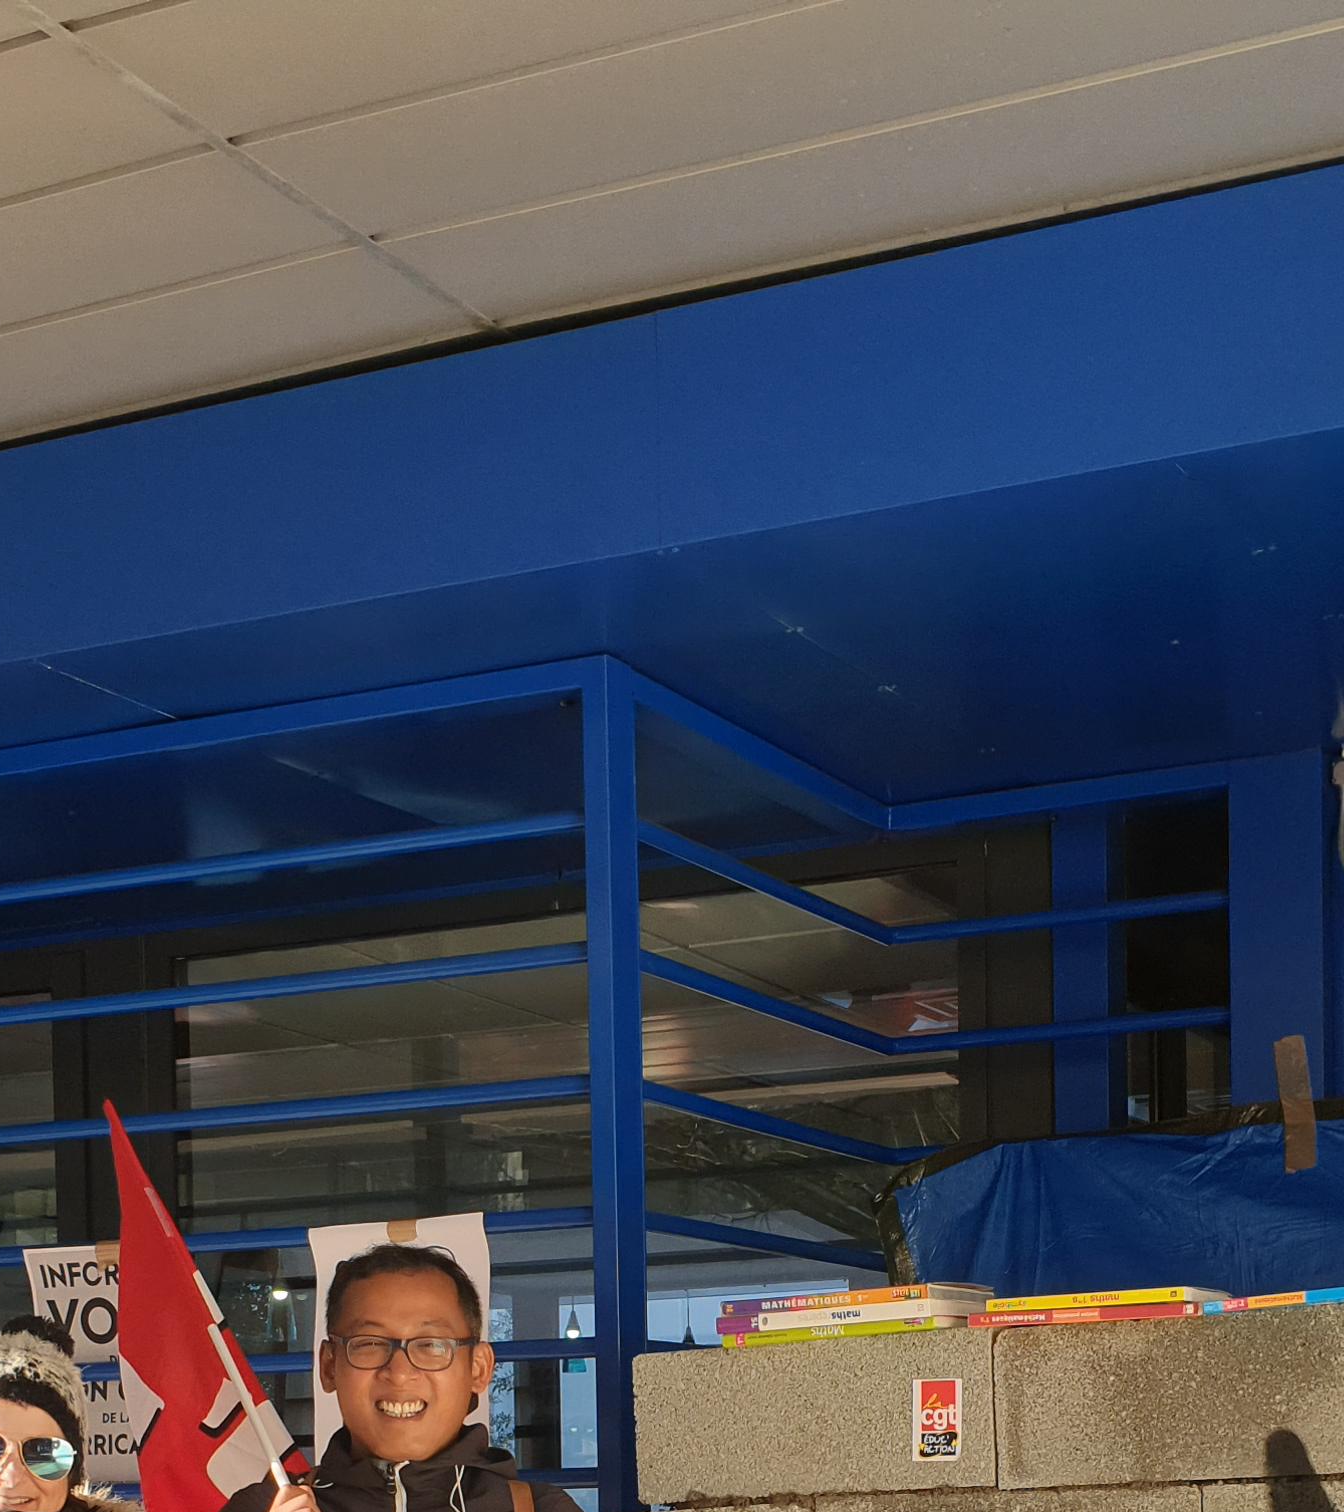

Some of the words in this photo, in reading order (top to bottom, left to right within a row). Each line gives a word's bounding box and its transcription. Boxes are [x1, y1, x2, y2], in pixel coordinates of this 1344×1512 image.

[761, 1294, 852, 1310] MATHÉMATIQUES
[1090, 1293, 1120, 1302] maths
[831, 1309, 861, 1320] maths
[811, 1325, 846, 1337] Maths
[103, 1413, 116, 1423] DE
[921, 1404, 957, 1430] cgt
